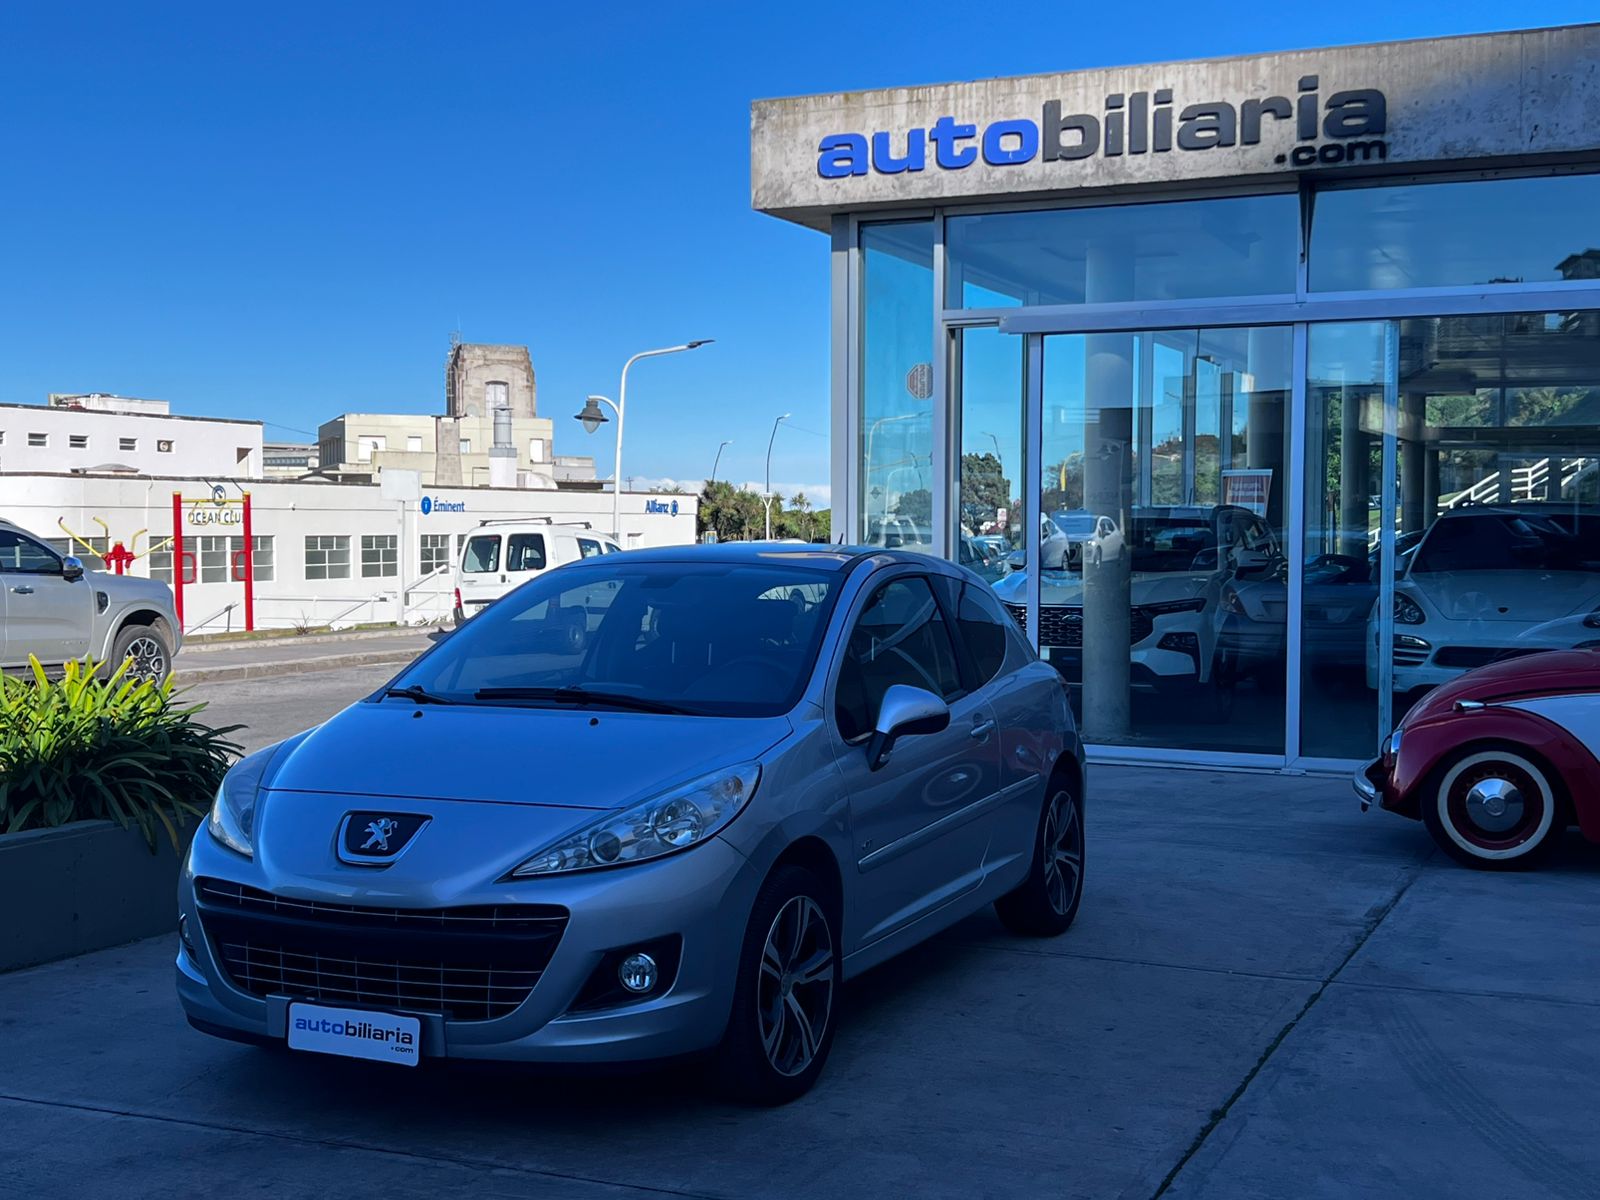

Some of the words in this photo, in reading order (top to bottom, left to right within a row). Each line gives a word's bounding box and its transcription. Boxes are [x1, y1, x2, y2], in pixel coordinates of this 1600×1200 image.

[818, 76, 1387, 178] autobiliaria
[1274, 140, 1387, 166] .com
[433, 496, 465, 512] Éminent
[224, 511, 244, 523] CLU
[295, 1018, 413, 1045] autobiliaria
[390, 1046, 414, 1054] .com
